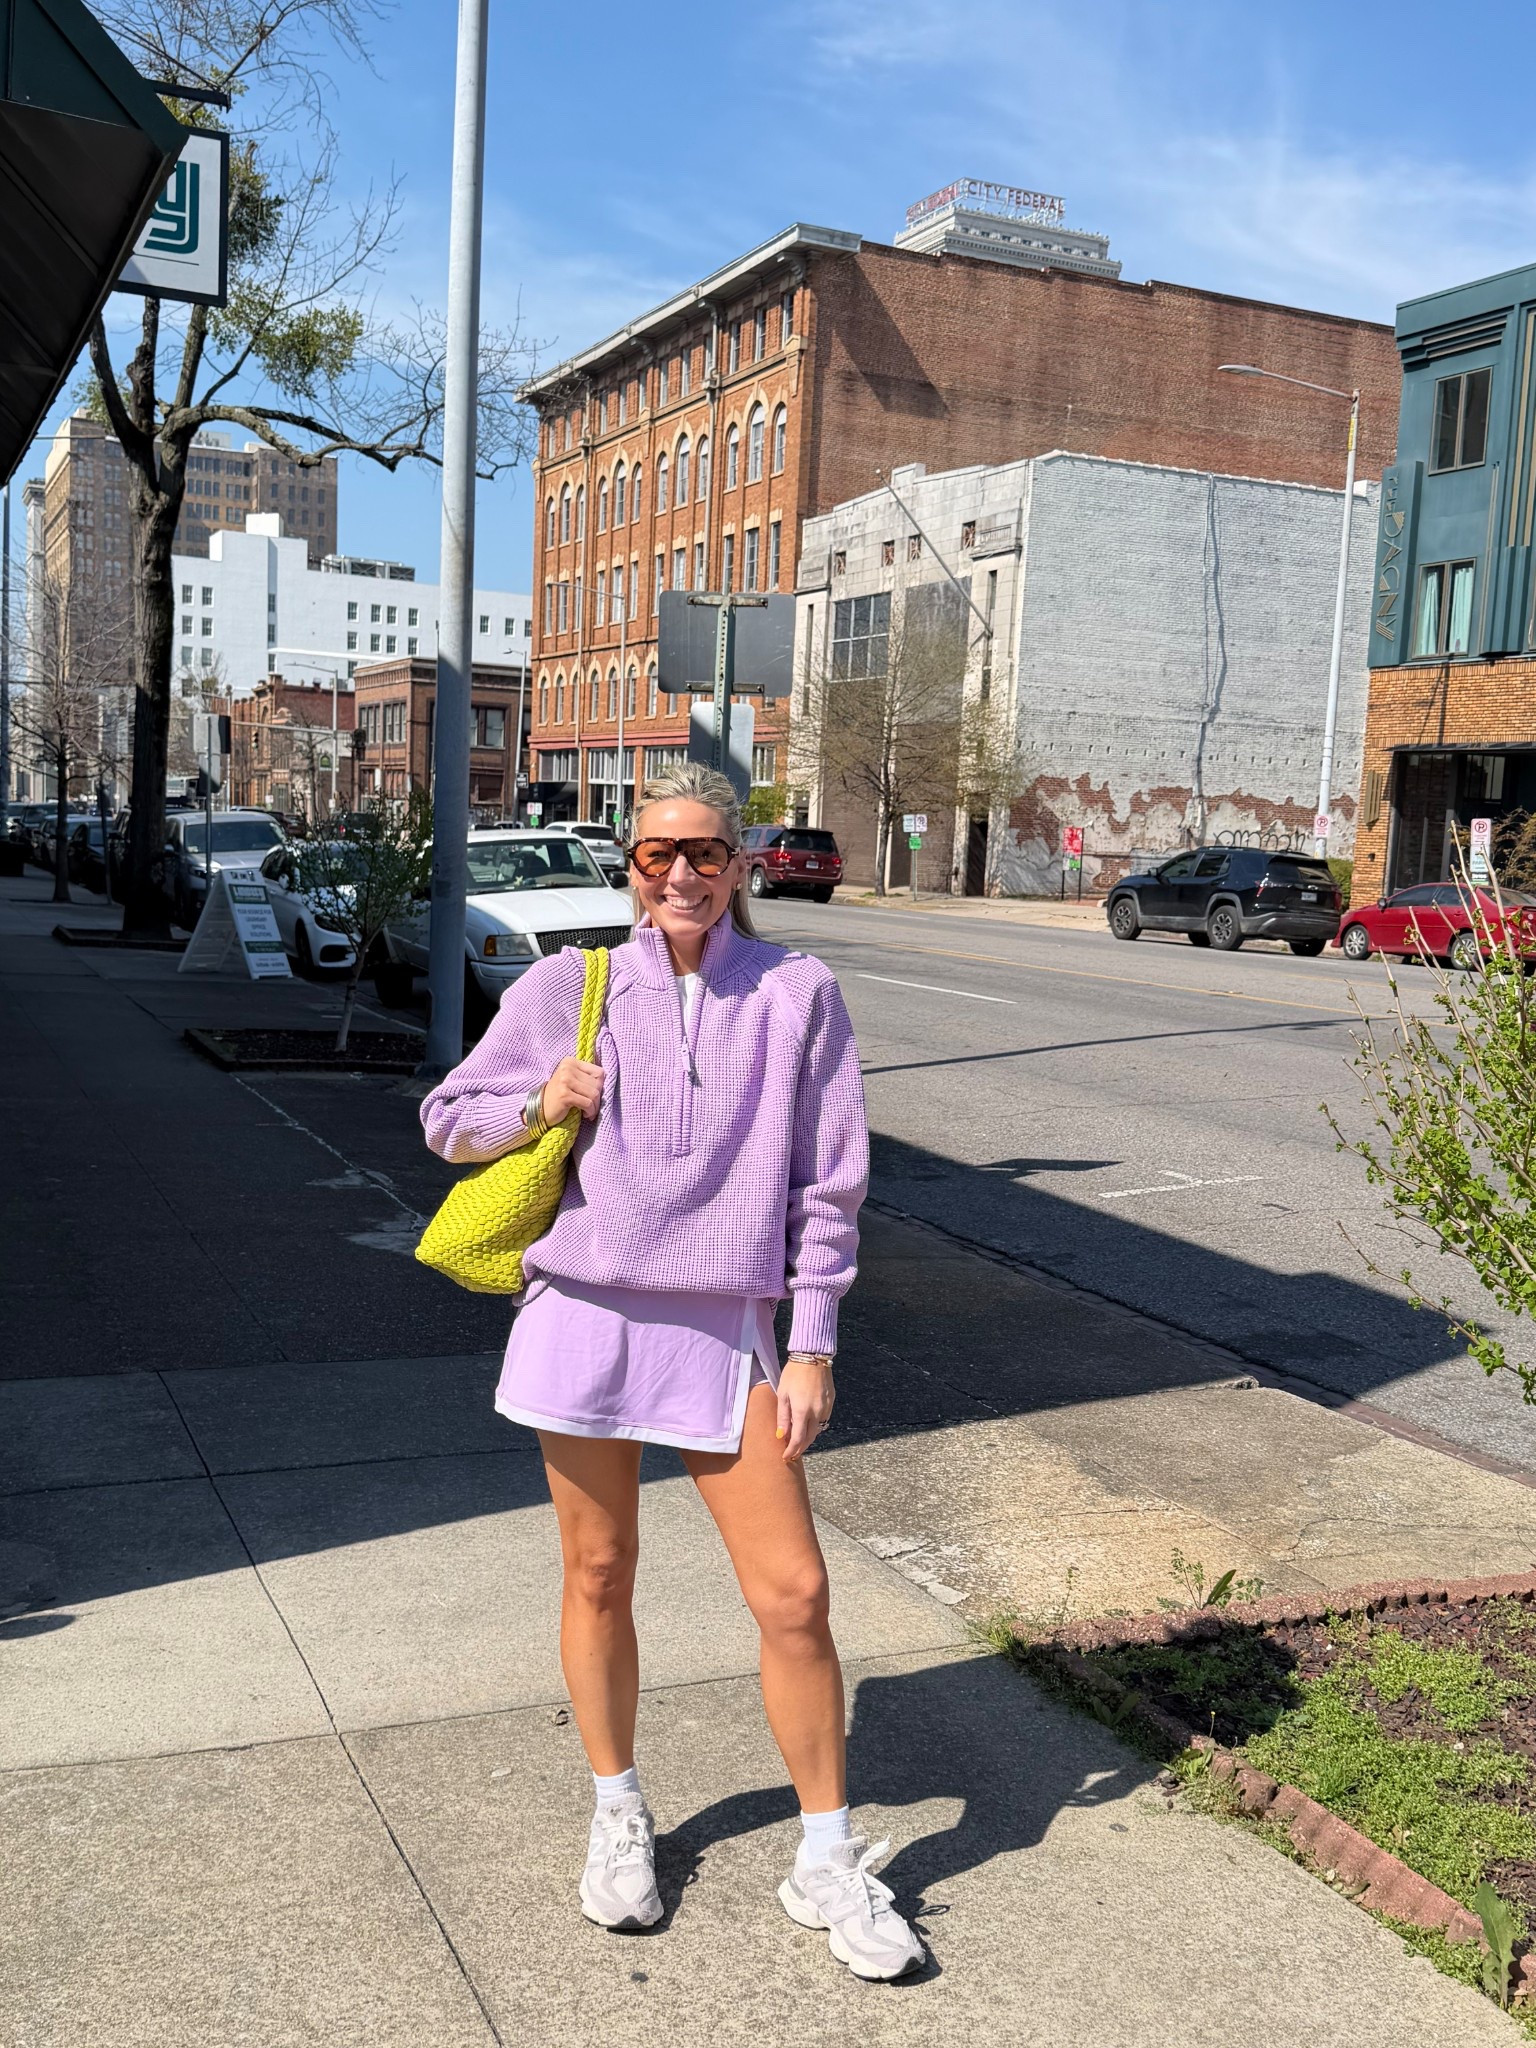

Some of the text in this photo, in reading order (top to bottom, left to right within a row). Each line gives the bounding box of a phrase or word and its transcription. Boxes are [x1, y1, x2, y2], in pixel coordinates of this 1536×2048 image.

[967, 181, 1064, 214] CITY FEDERAL
[1375, 511, 1405, 641] DAGNY
